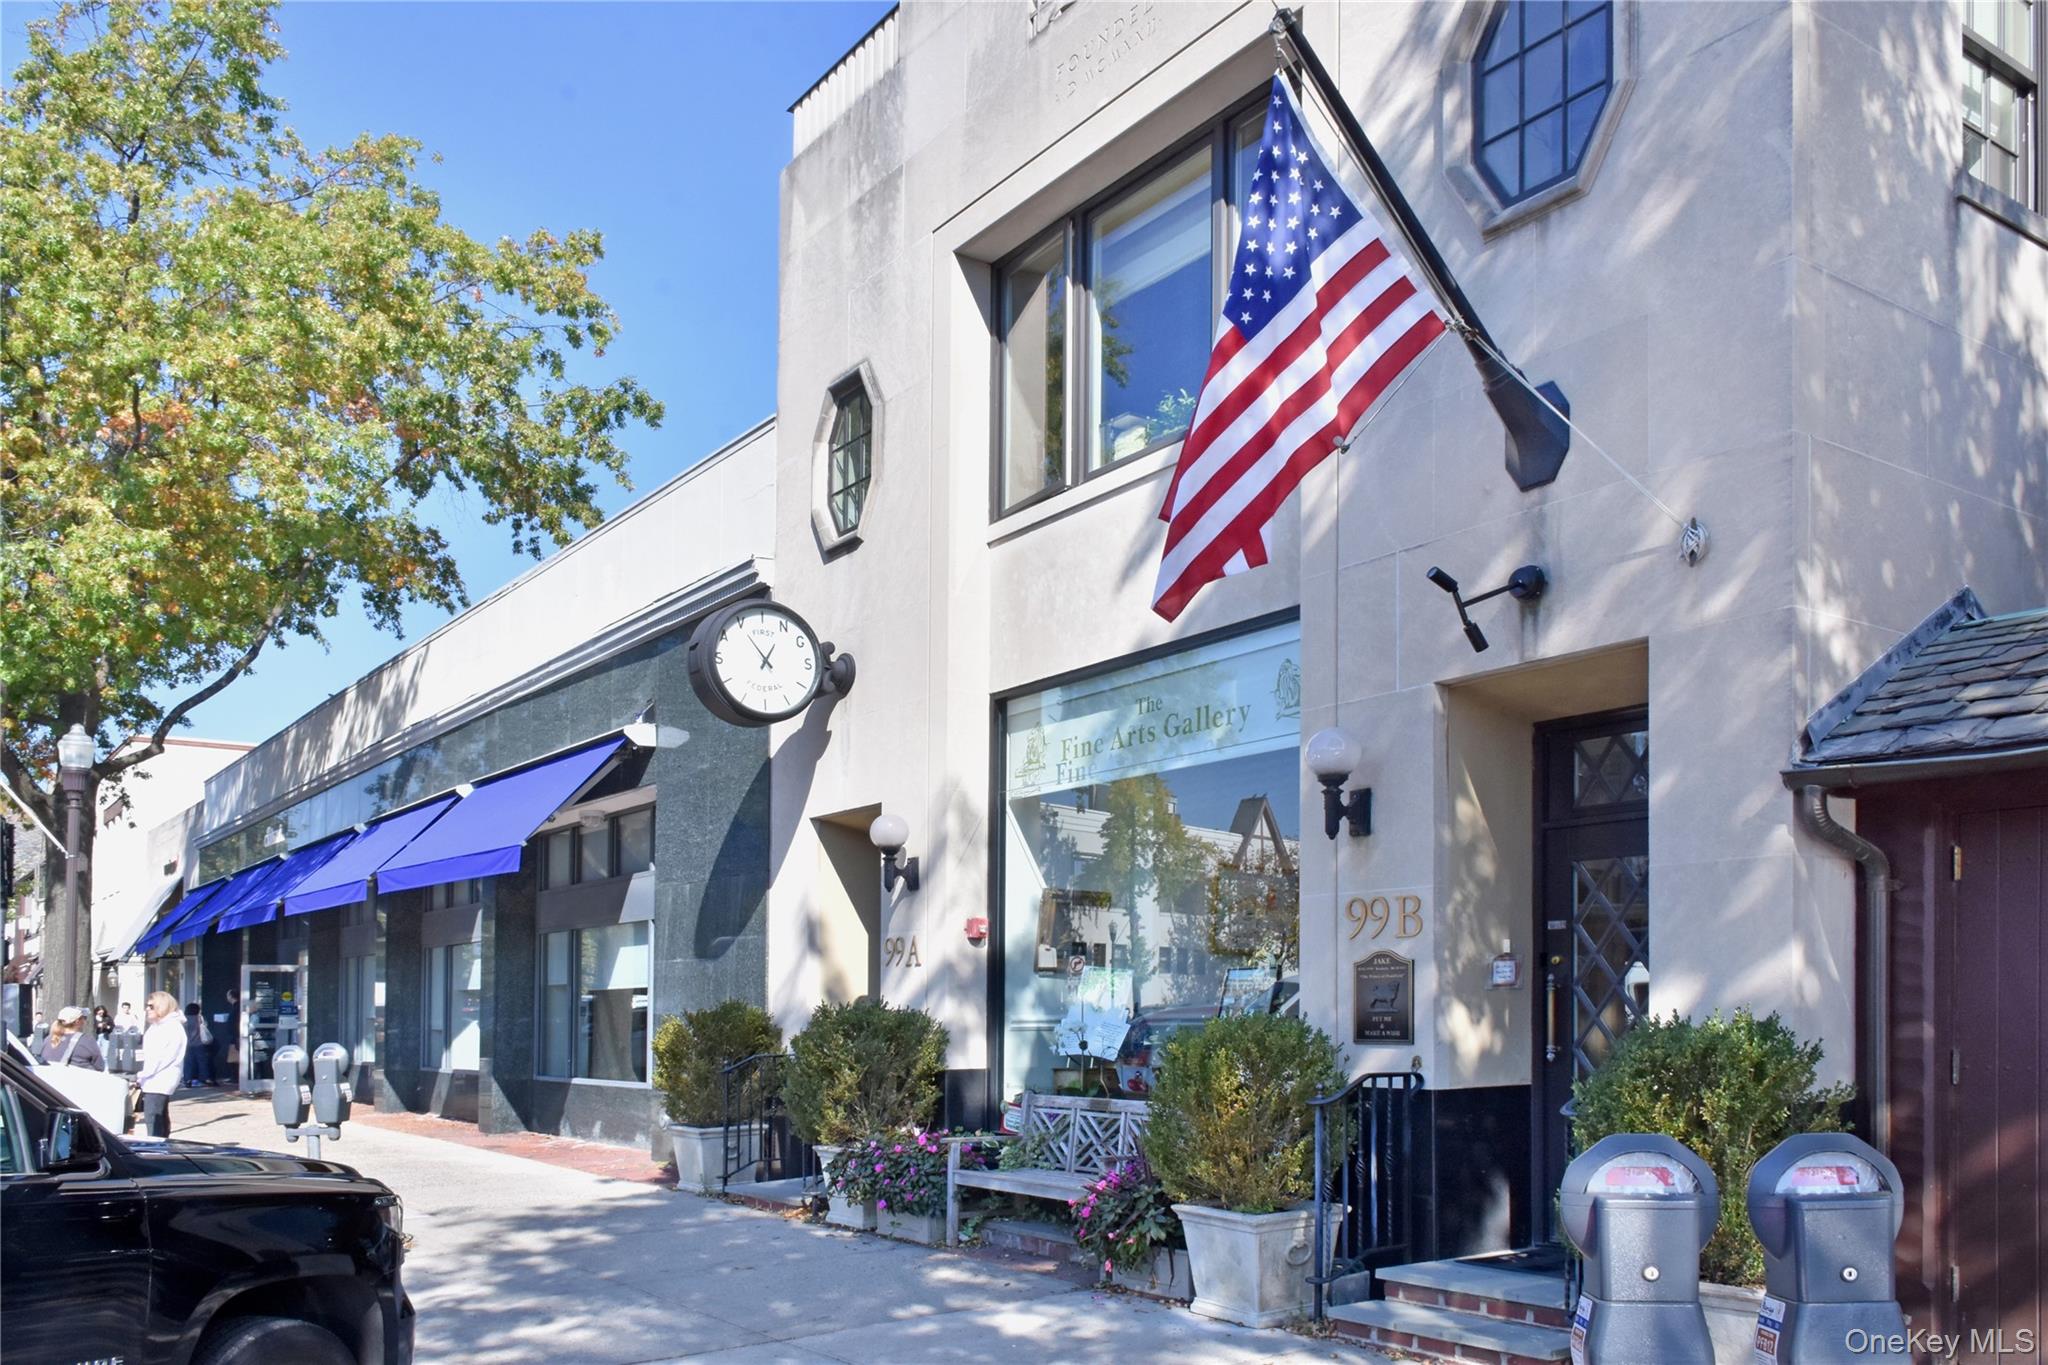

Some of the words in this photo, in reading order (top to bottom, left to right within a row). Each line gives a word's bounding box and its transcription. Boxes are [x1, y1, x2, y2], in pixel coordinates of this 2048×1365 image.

[752, 628, 775, 638] FIRST
[746, 680, 783, 692] FEDERAL
[1135, 695, 1164, 715] The
[1060, 737, 1104, 762] Fine
[1110, 725, 1157, 751] Arts
[1163, 704, 1252, 738] Gallery
